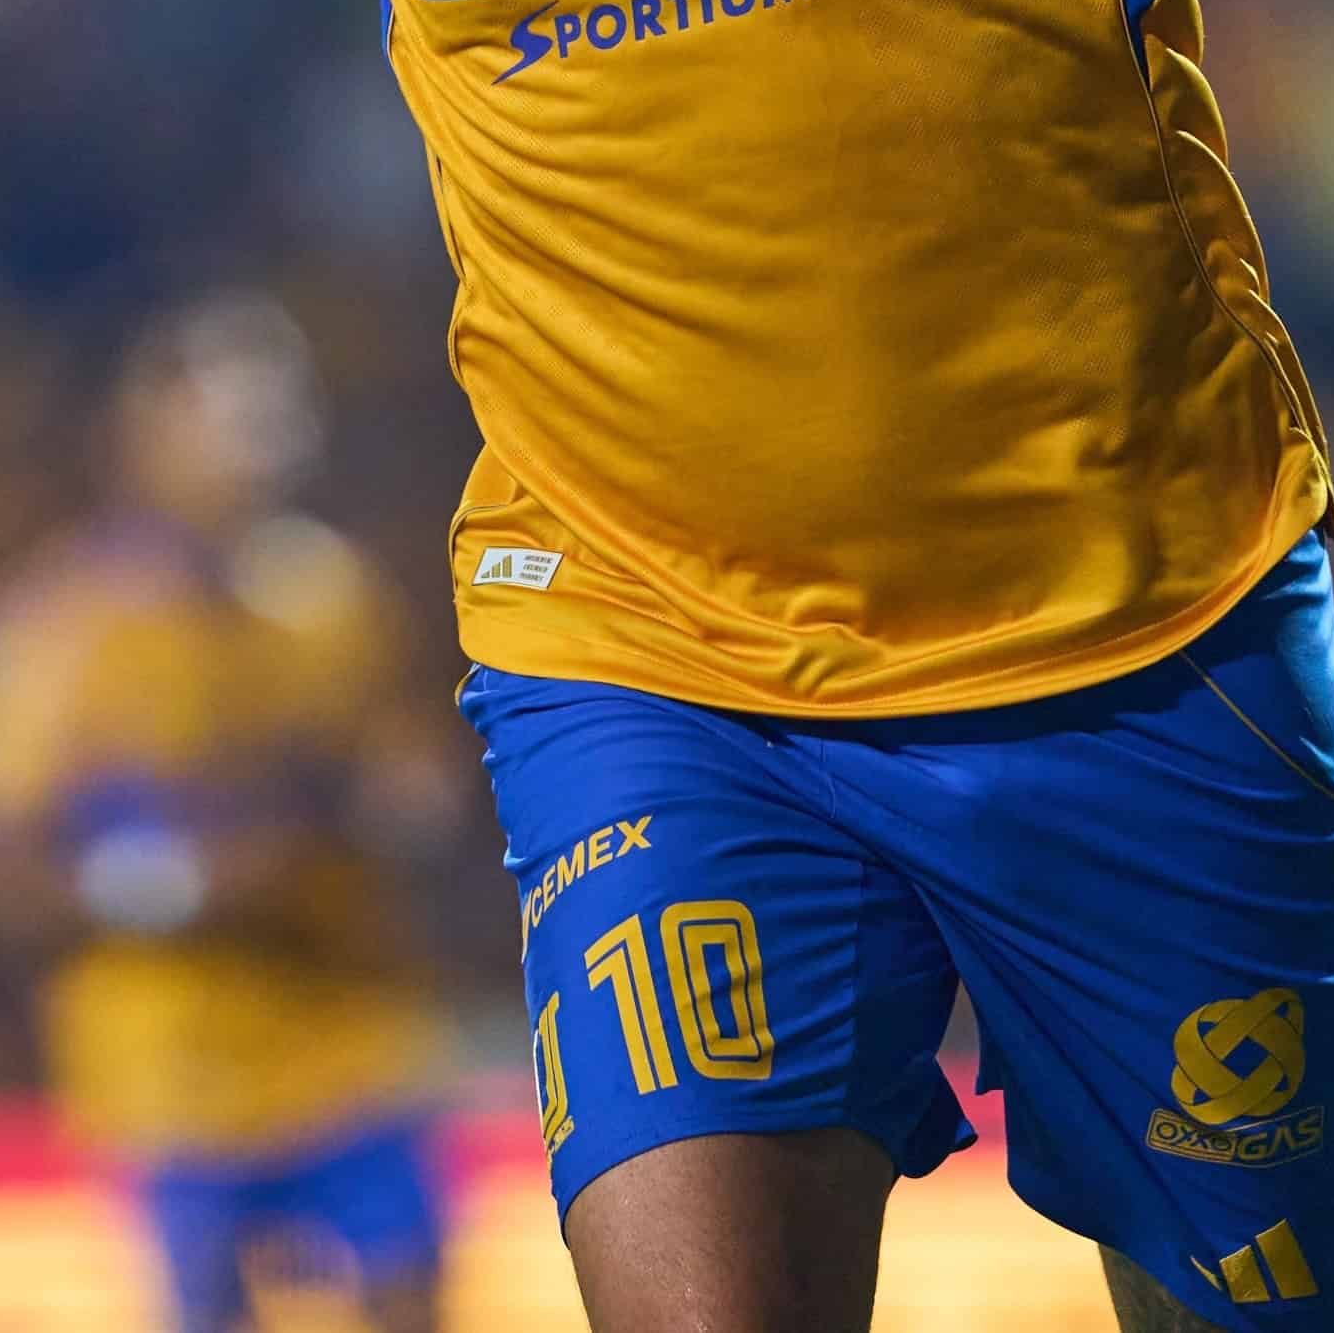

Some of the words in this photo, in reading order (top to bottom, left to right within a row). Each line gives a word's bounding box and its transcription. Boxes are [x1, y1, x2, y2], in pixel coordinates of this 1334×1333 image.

[531, 814, 653, 929] CEMEX
[584, 899, 776, 1097] 10
[1237, 1114, 1322, 1161] GAS
